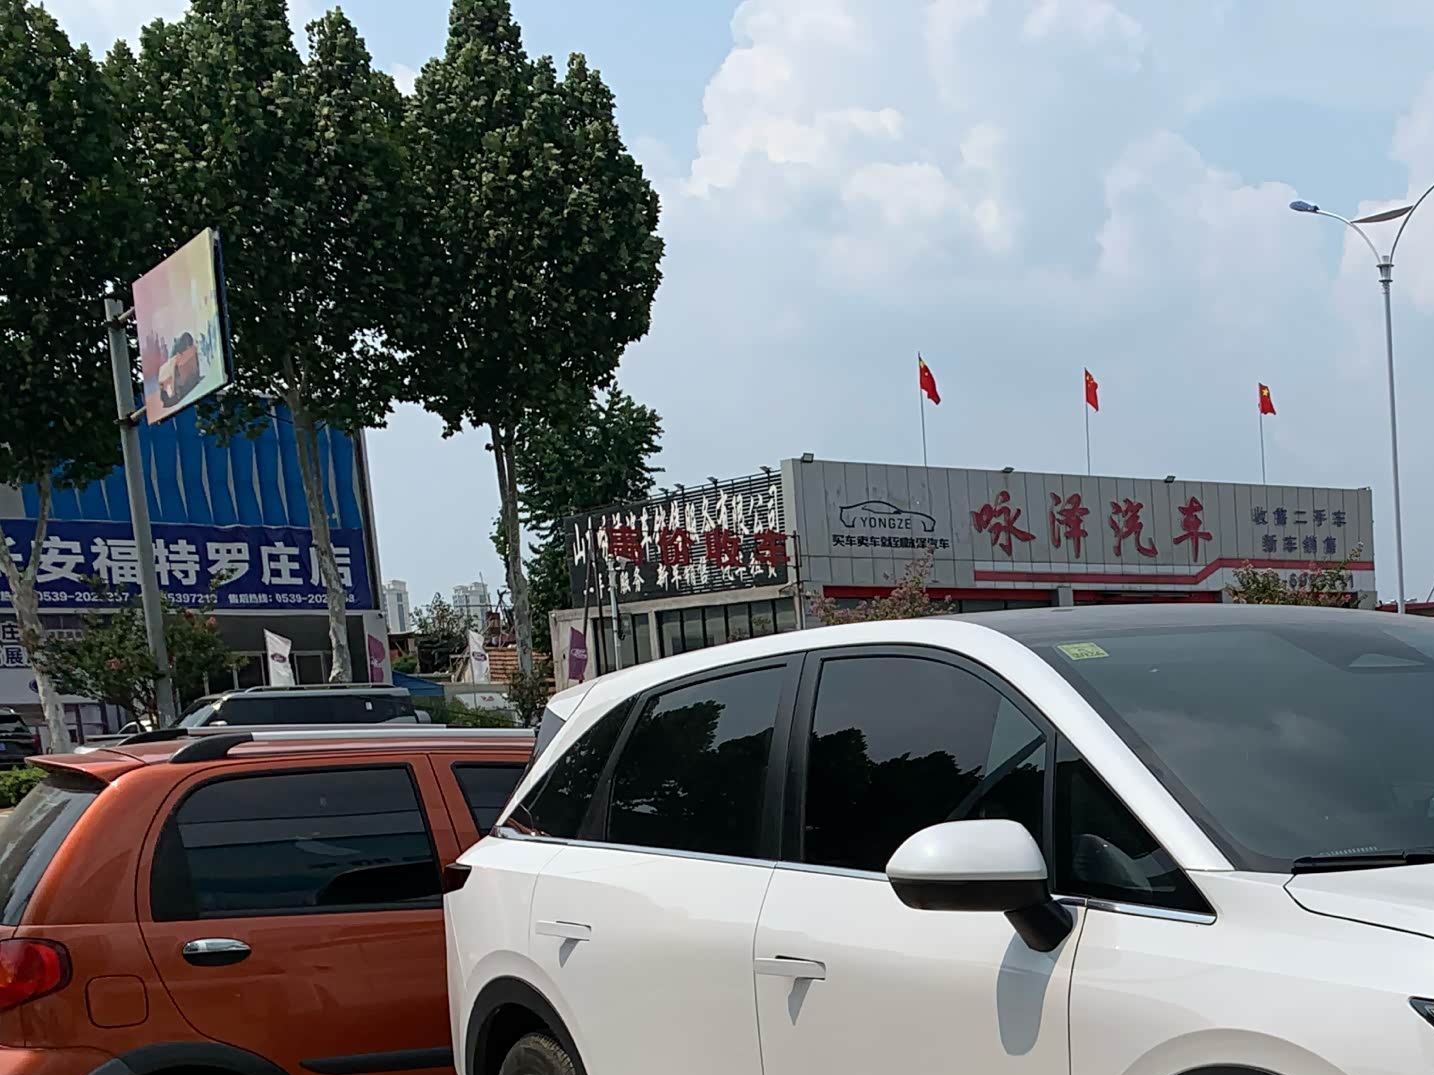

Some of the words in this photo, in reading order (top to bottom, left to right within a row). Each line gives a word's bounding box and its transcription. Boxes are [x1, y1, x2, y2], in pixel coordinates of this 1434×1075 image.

[859, 516, 912, 530] YONGZE
[970, 490, 1213, 563] 咏泽汽车
